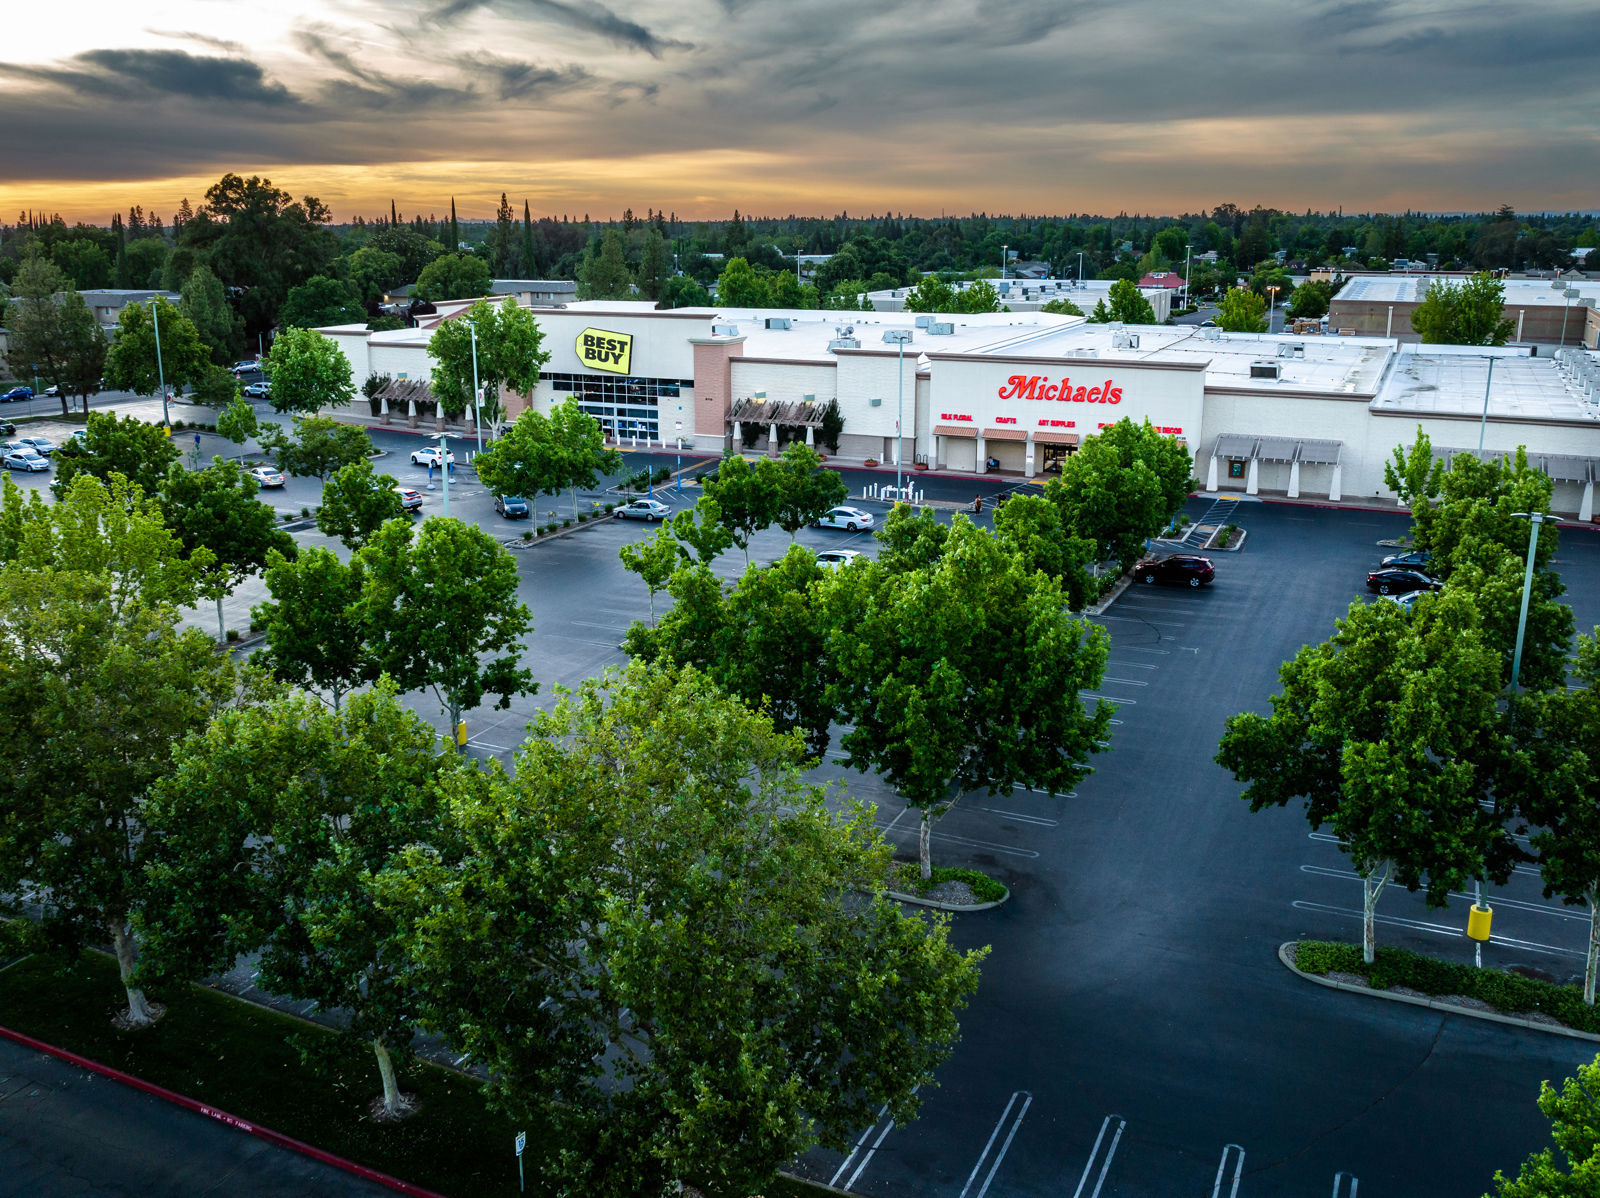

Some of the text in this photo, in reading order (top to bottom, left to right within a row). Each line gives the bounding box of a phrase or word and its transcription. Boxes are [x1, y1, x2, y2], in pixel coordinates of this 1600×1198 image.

[584, 334, 628, 353] BEST
[585, 347, 624, 365] BUY
[998, 375, 1123, 405] Michaels
[953, 413, 973, 422] FLORAL
[995, 416, 1017, 425] CRAFTS
[1050, 420, 1076, 428] SUPPLIES
[1162, 426, 1182, 434] DECOR
[235, 1120, 253, 1132] PARKING
